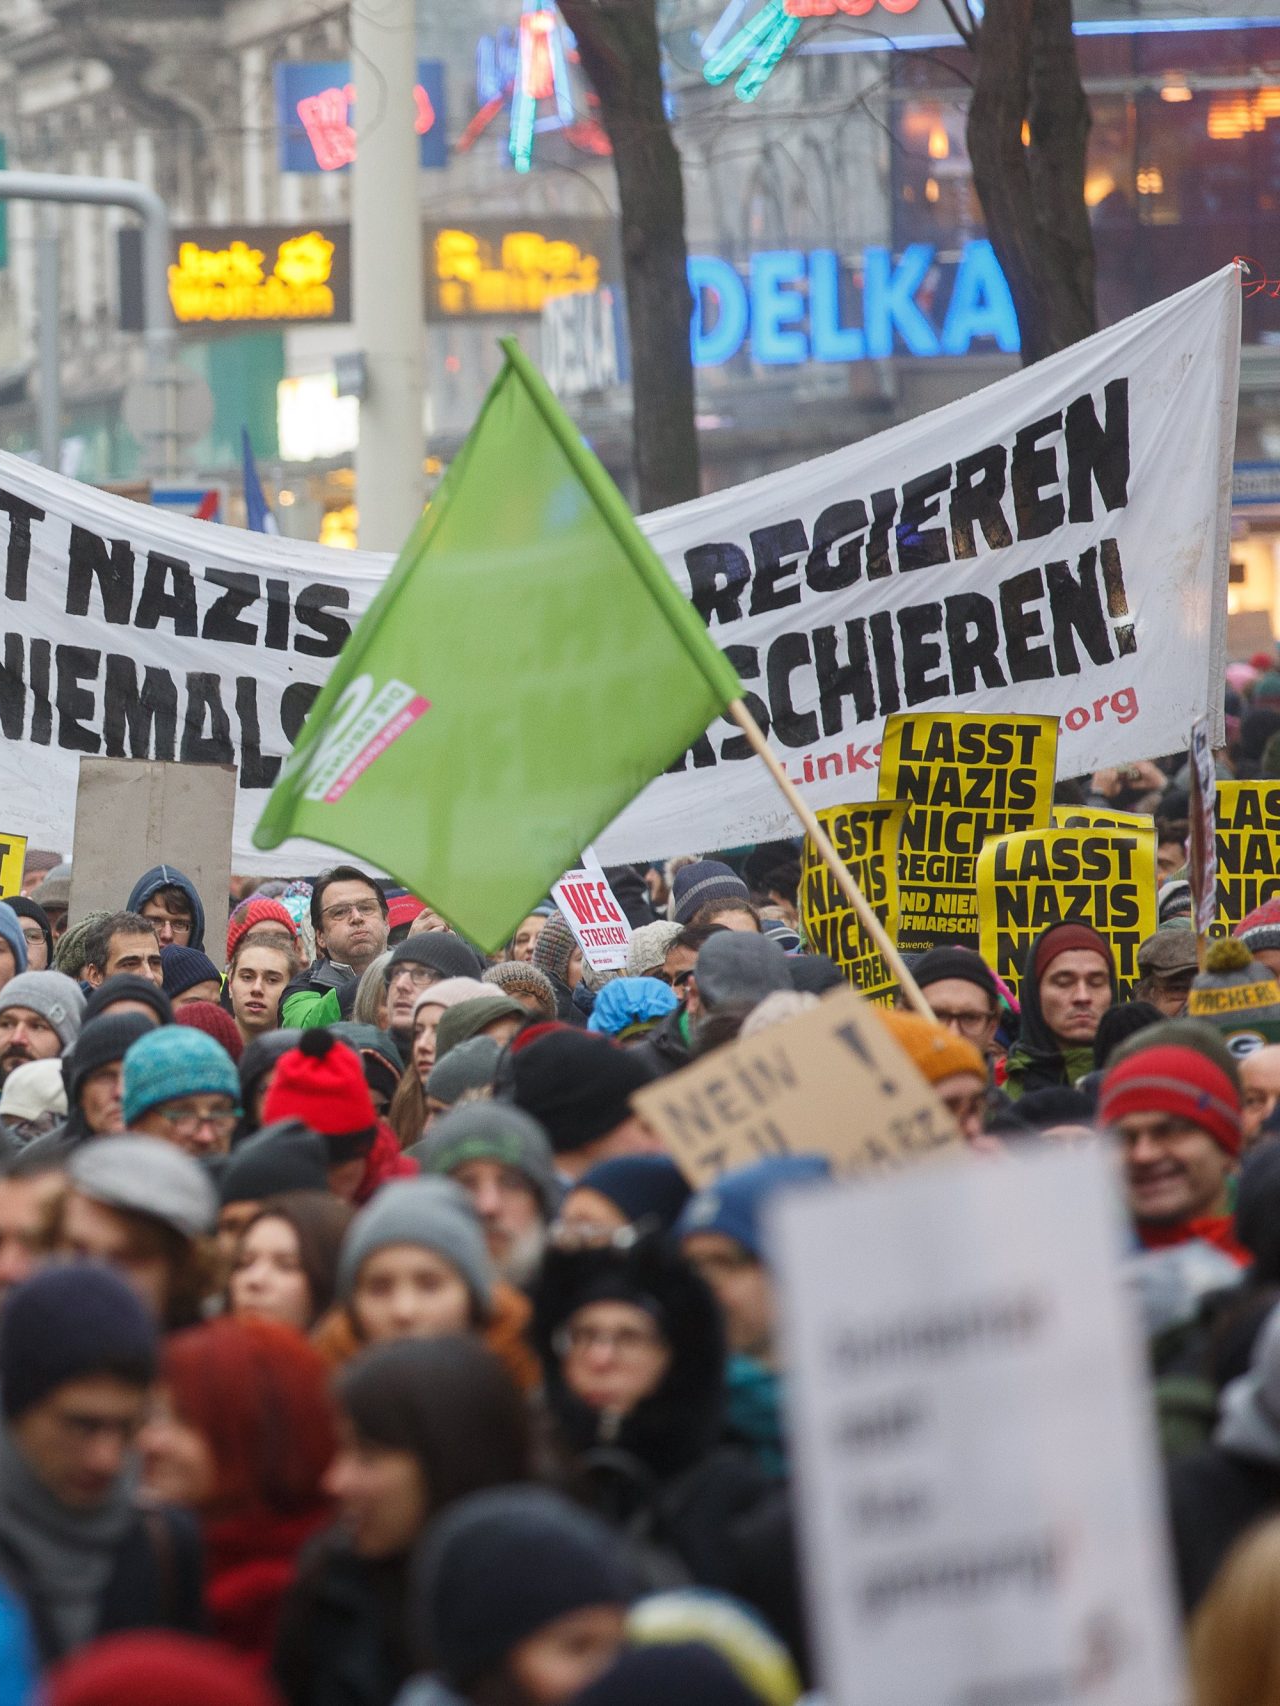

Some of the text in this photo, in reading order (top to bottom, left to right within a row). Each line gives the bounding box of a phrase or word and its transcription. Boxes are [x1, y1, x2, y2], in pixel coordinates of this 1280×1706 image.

[687, 239, 1019, 365] DELKA
[66, 523, 352, 658] NAZIS
[684, 377, 1130, 628] REGIEREN
[663, 538, 1138, 776] SCHIEREN!
[899, 721, 1042, 765] LASST
[895, 765, 1038, 810] NAZIS
[899, 809, 1034, 854] NICHT
[1216, 789, 1280, 831] LAS
[807, 809, 893, 870] LASST
[994, 838, 1138, 882] LASST
[1216, 833, 1280, 875] NA
[898, 853, 977, 884] REGIE
[559, 881, 623, 925] WEG
[899, 914, 979, 934] FMARSCH
[900, 891, 931, 913] ND
[995, 883, 1140, 928] NAZIS
[579, 926, 630, 948] STREIKEN!
